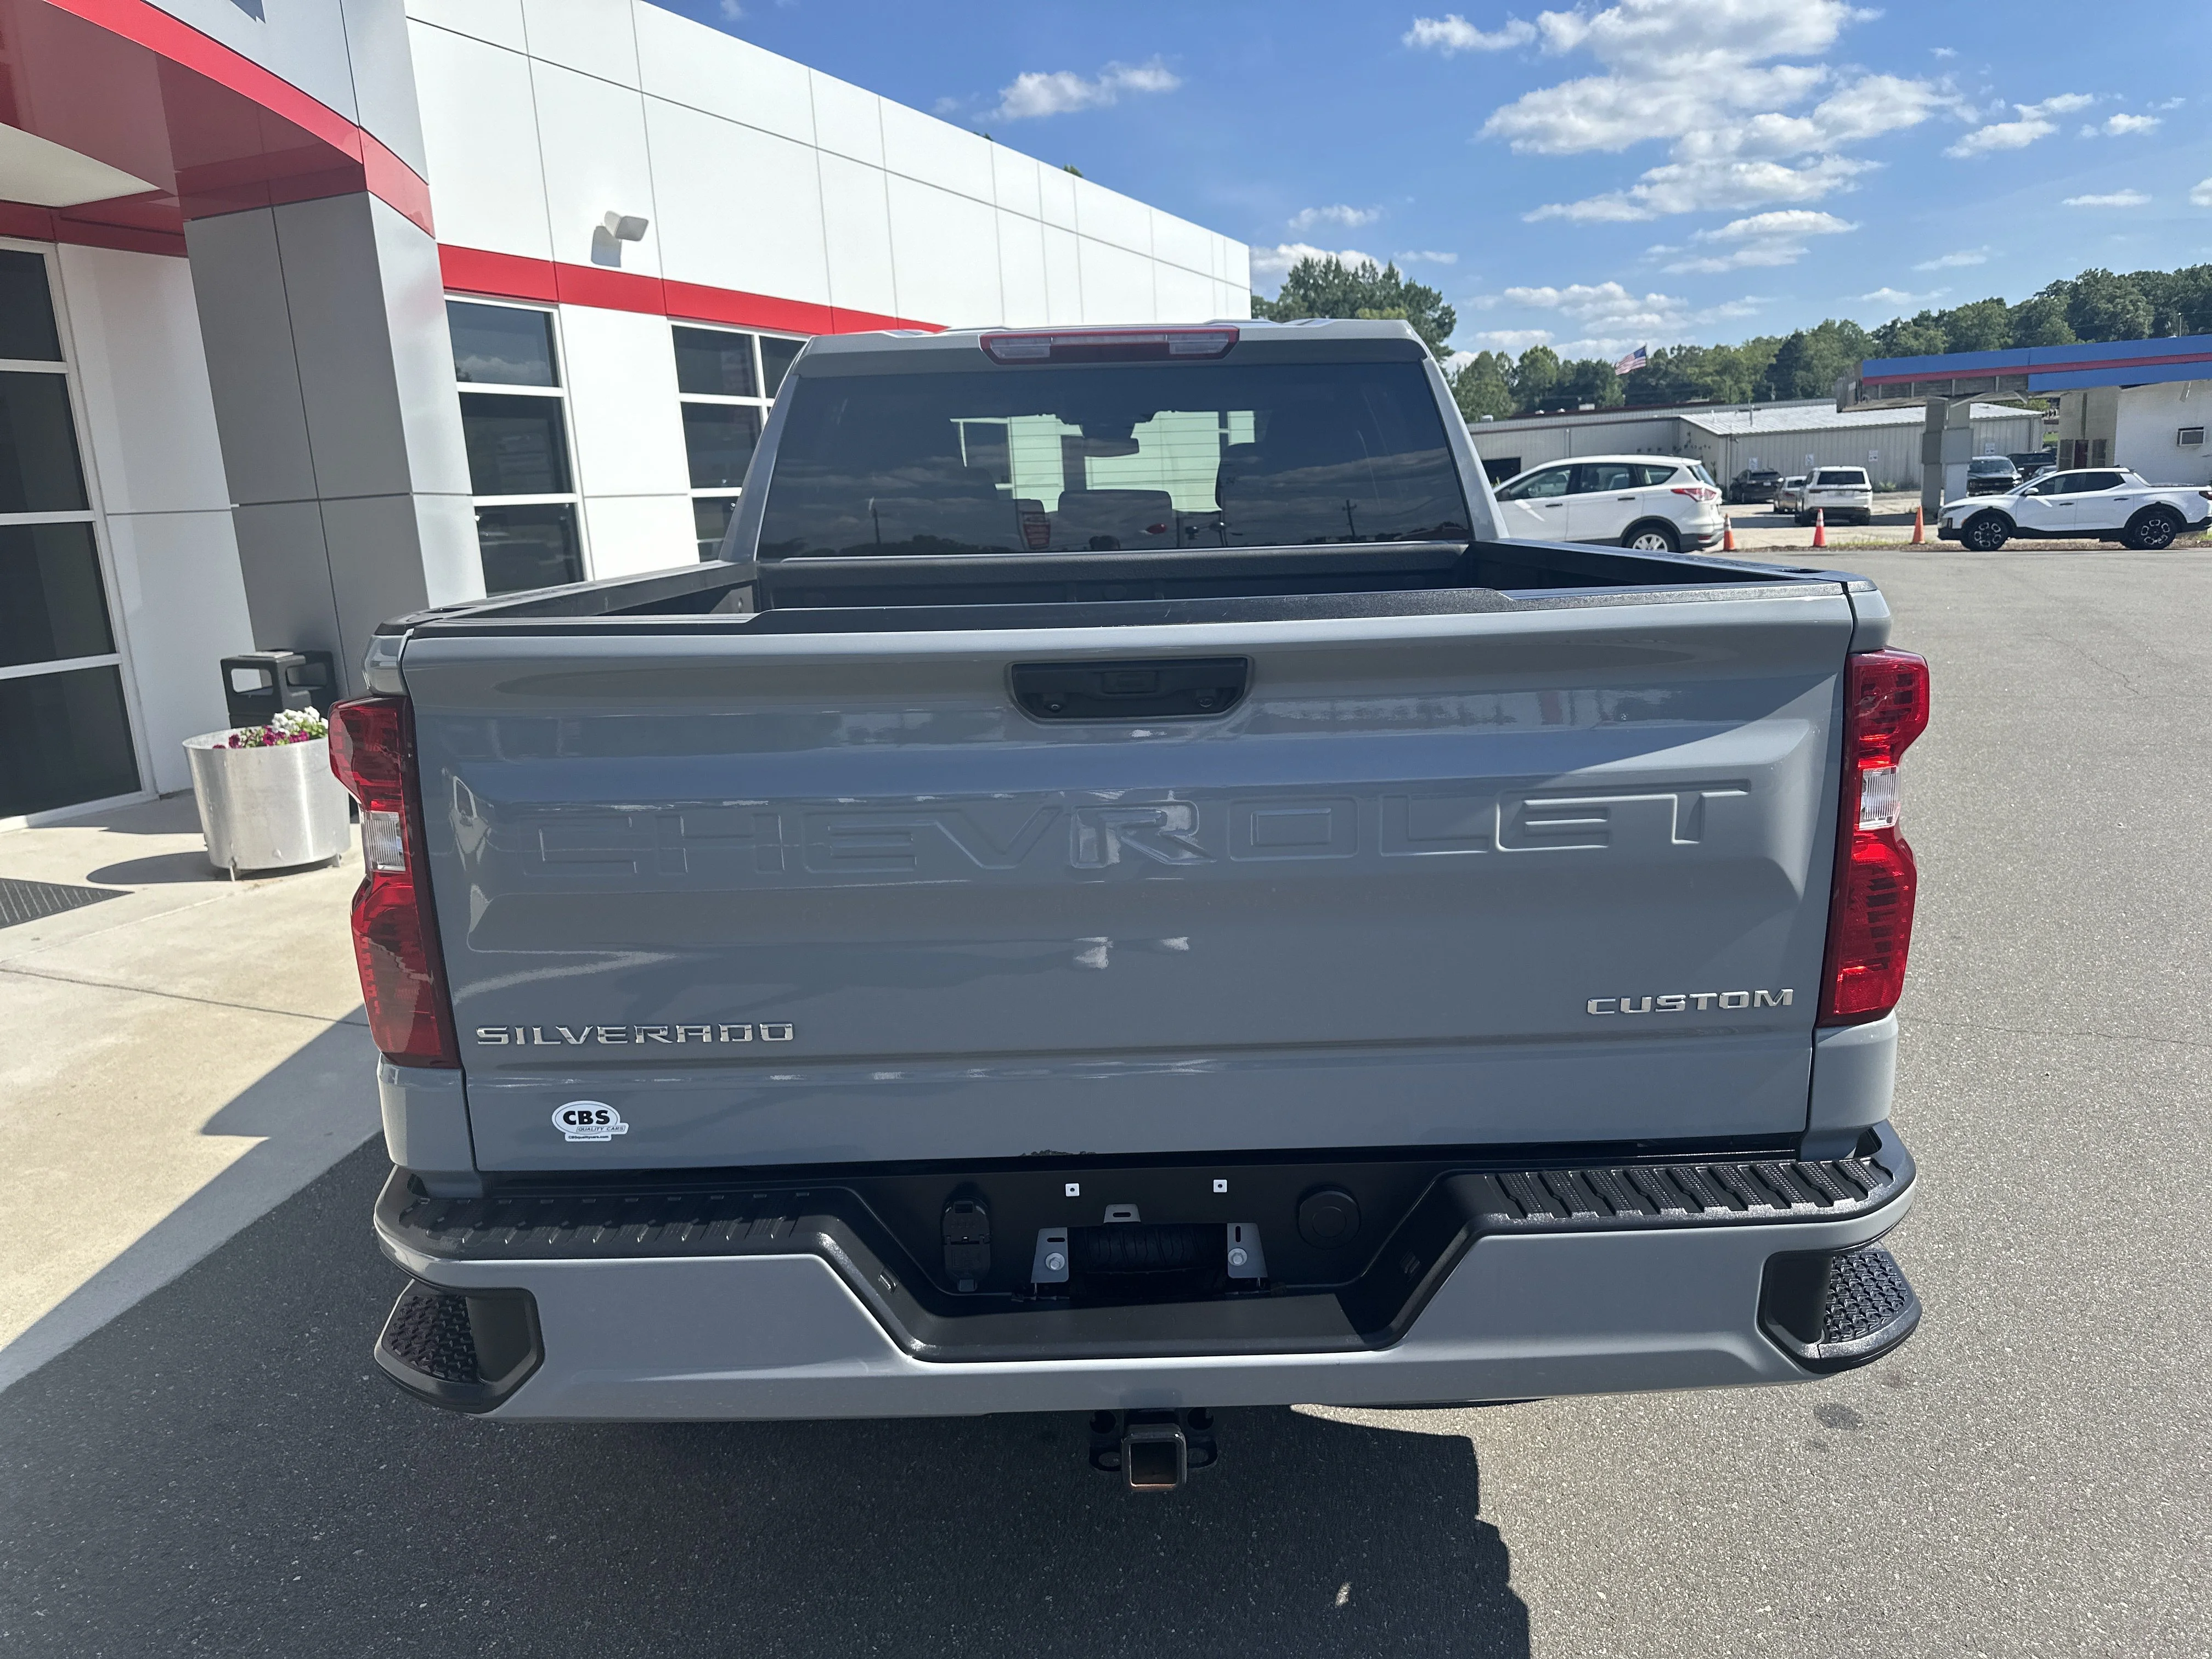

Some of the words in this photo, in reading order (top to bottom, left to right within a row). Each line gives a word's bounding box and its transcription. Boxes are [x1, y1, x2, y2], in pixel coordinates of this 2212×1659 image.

[522, 780, 1751, 876] CHEVROLET
[1587, 988, 1794, 1015] CUSTOM
[476, 1022, 794, 1045] SILVERADO
[563, 1110, 610, 1125] CBS
